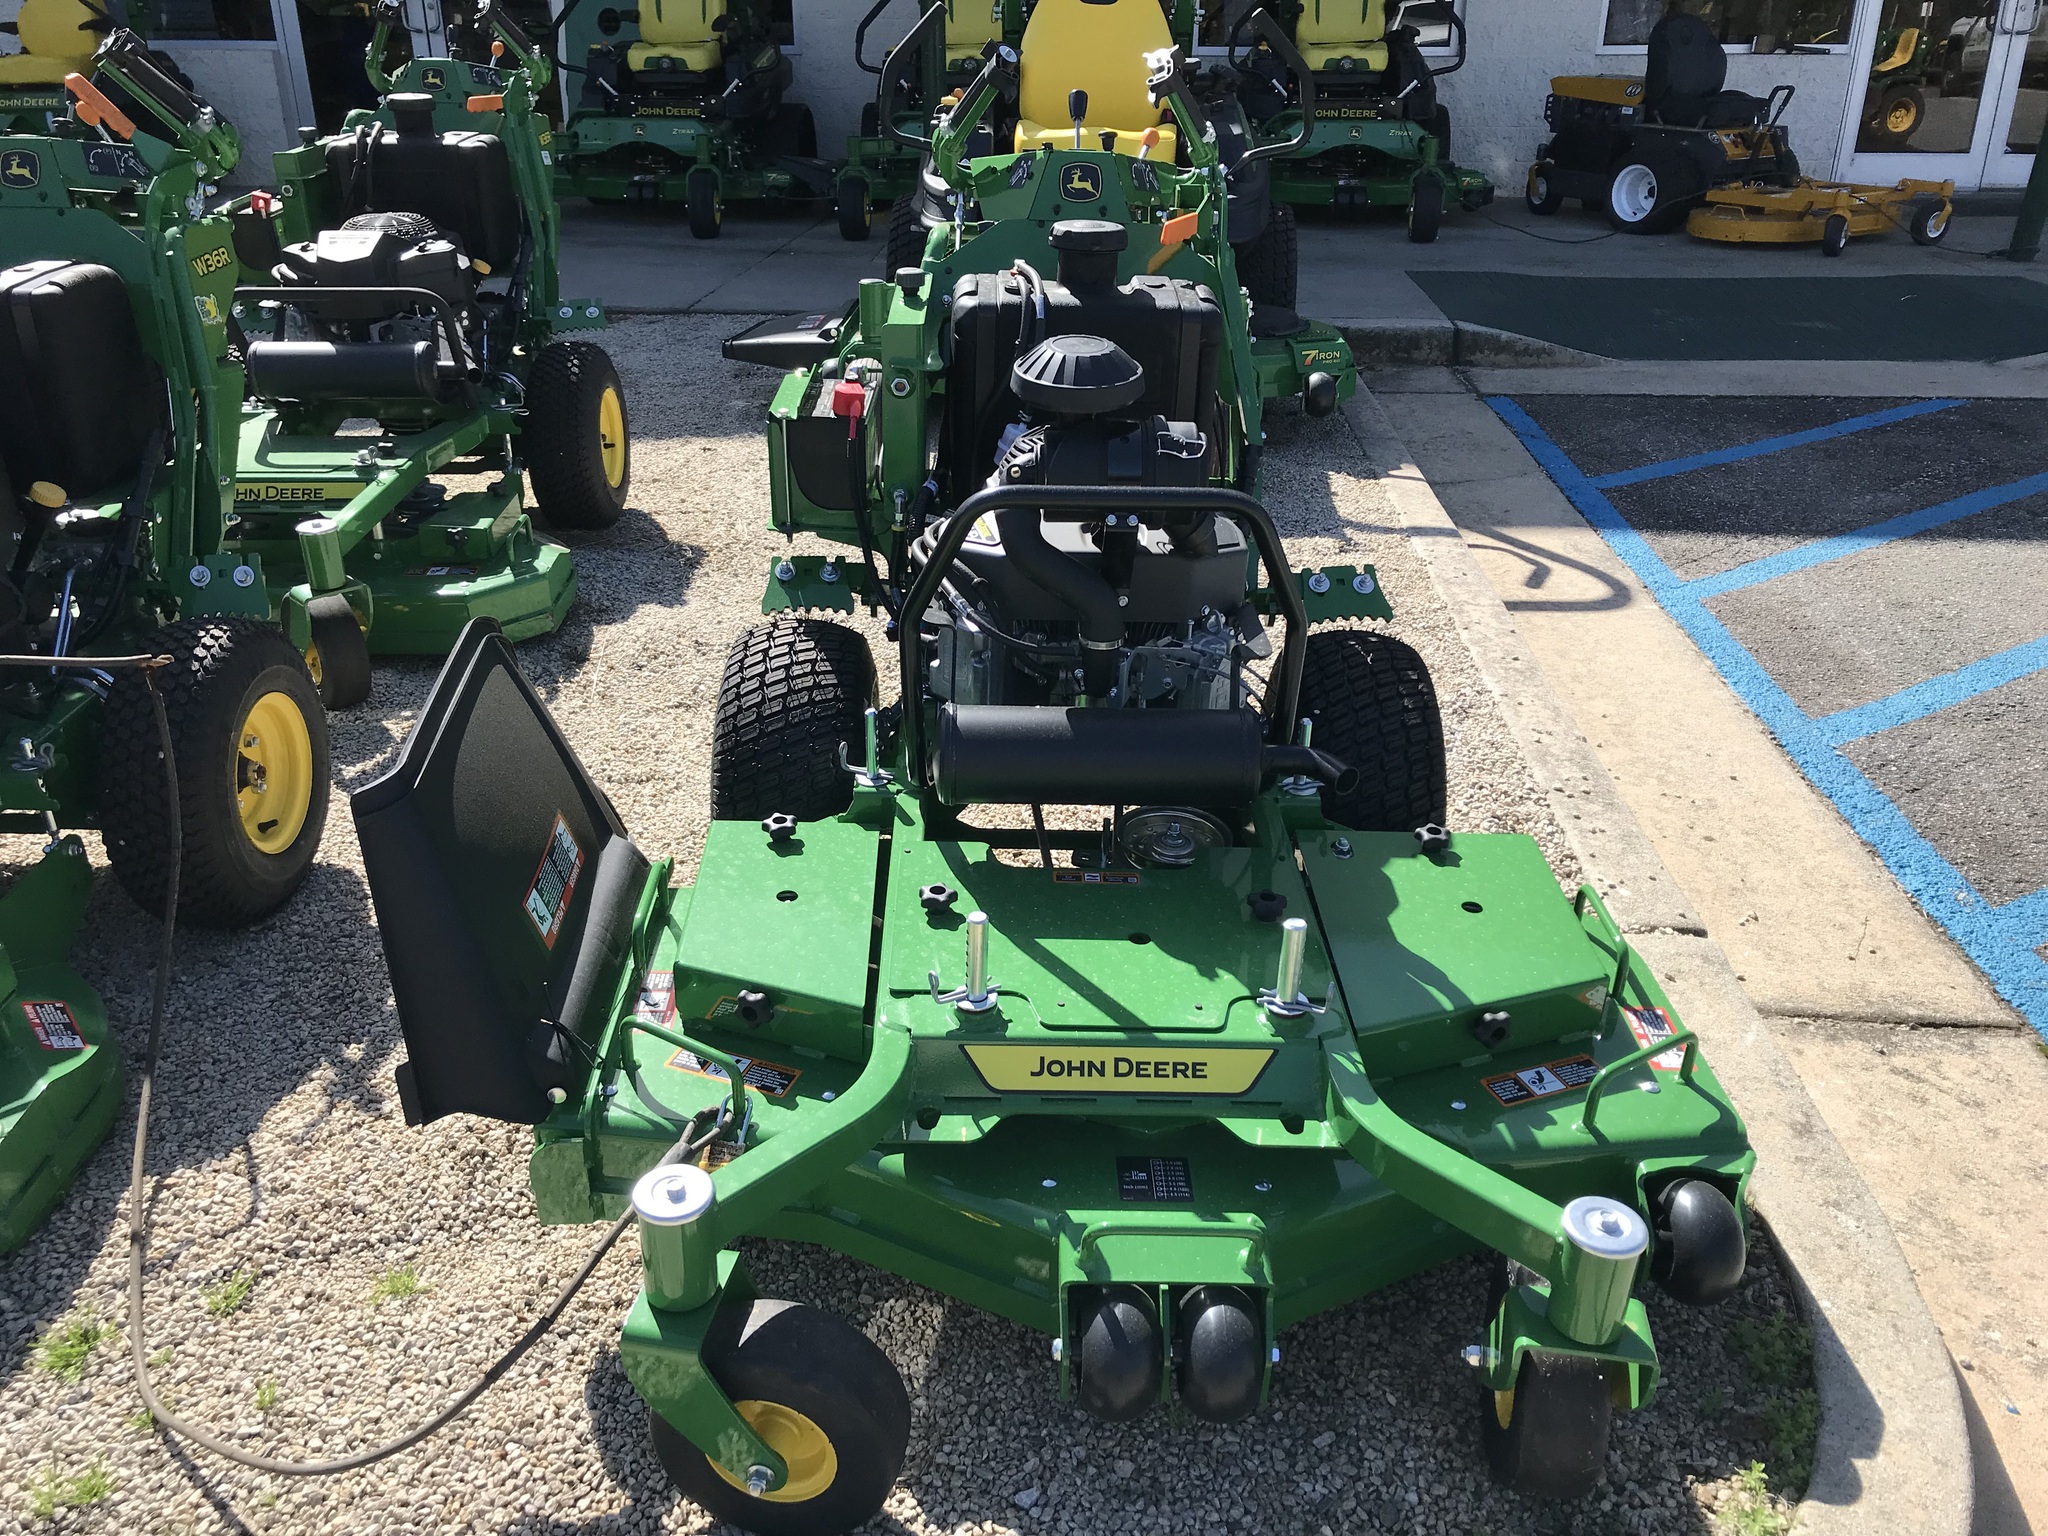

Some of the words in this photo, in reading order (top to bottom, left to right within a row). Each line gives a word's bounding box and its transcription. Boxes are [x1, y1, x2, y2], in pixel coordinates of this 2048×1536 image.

[0, 98, 21, 107] OHN
[23, 97, 59, 106] DEERE
[635, 106, 664, 115] JOHN
[666, 106, 701, 116] DEERE
[1315, 109, 1338, 117] OHN
[1341, 108, 1377, 117] DEERE
[191, 246, 232, 277] W36R
[236, 488, 260, 499] HN
[265, 486, 324, 499] DEERE
[1030, 1056, 1106, 1077] JOHN
[1114, 1057, 1208, 1079] DEERE
